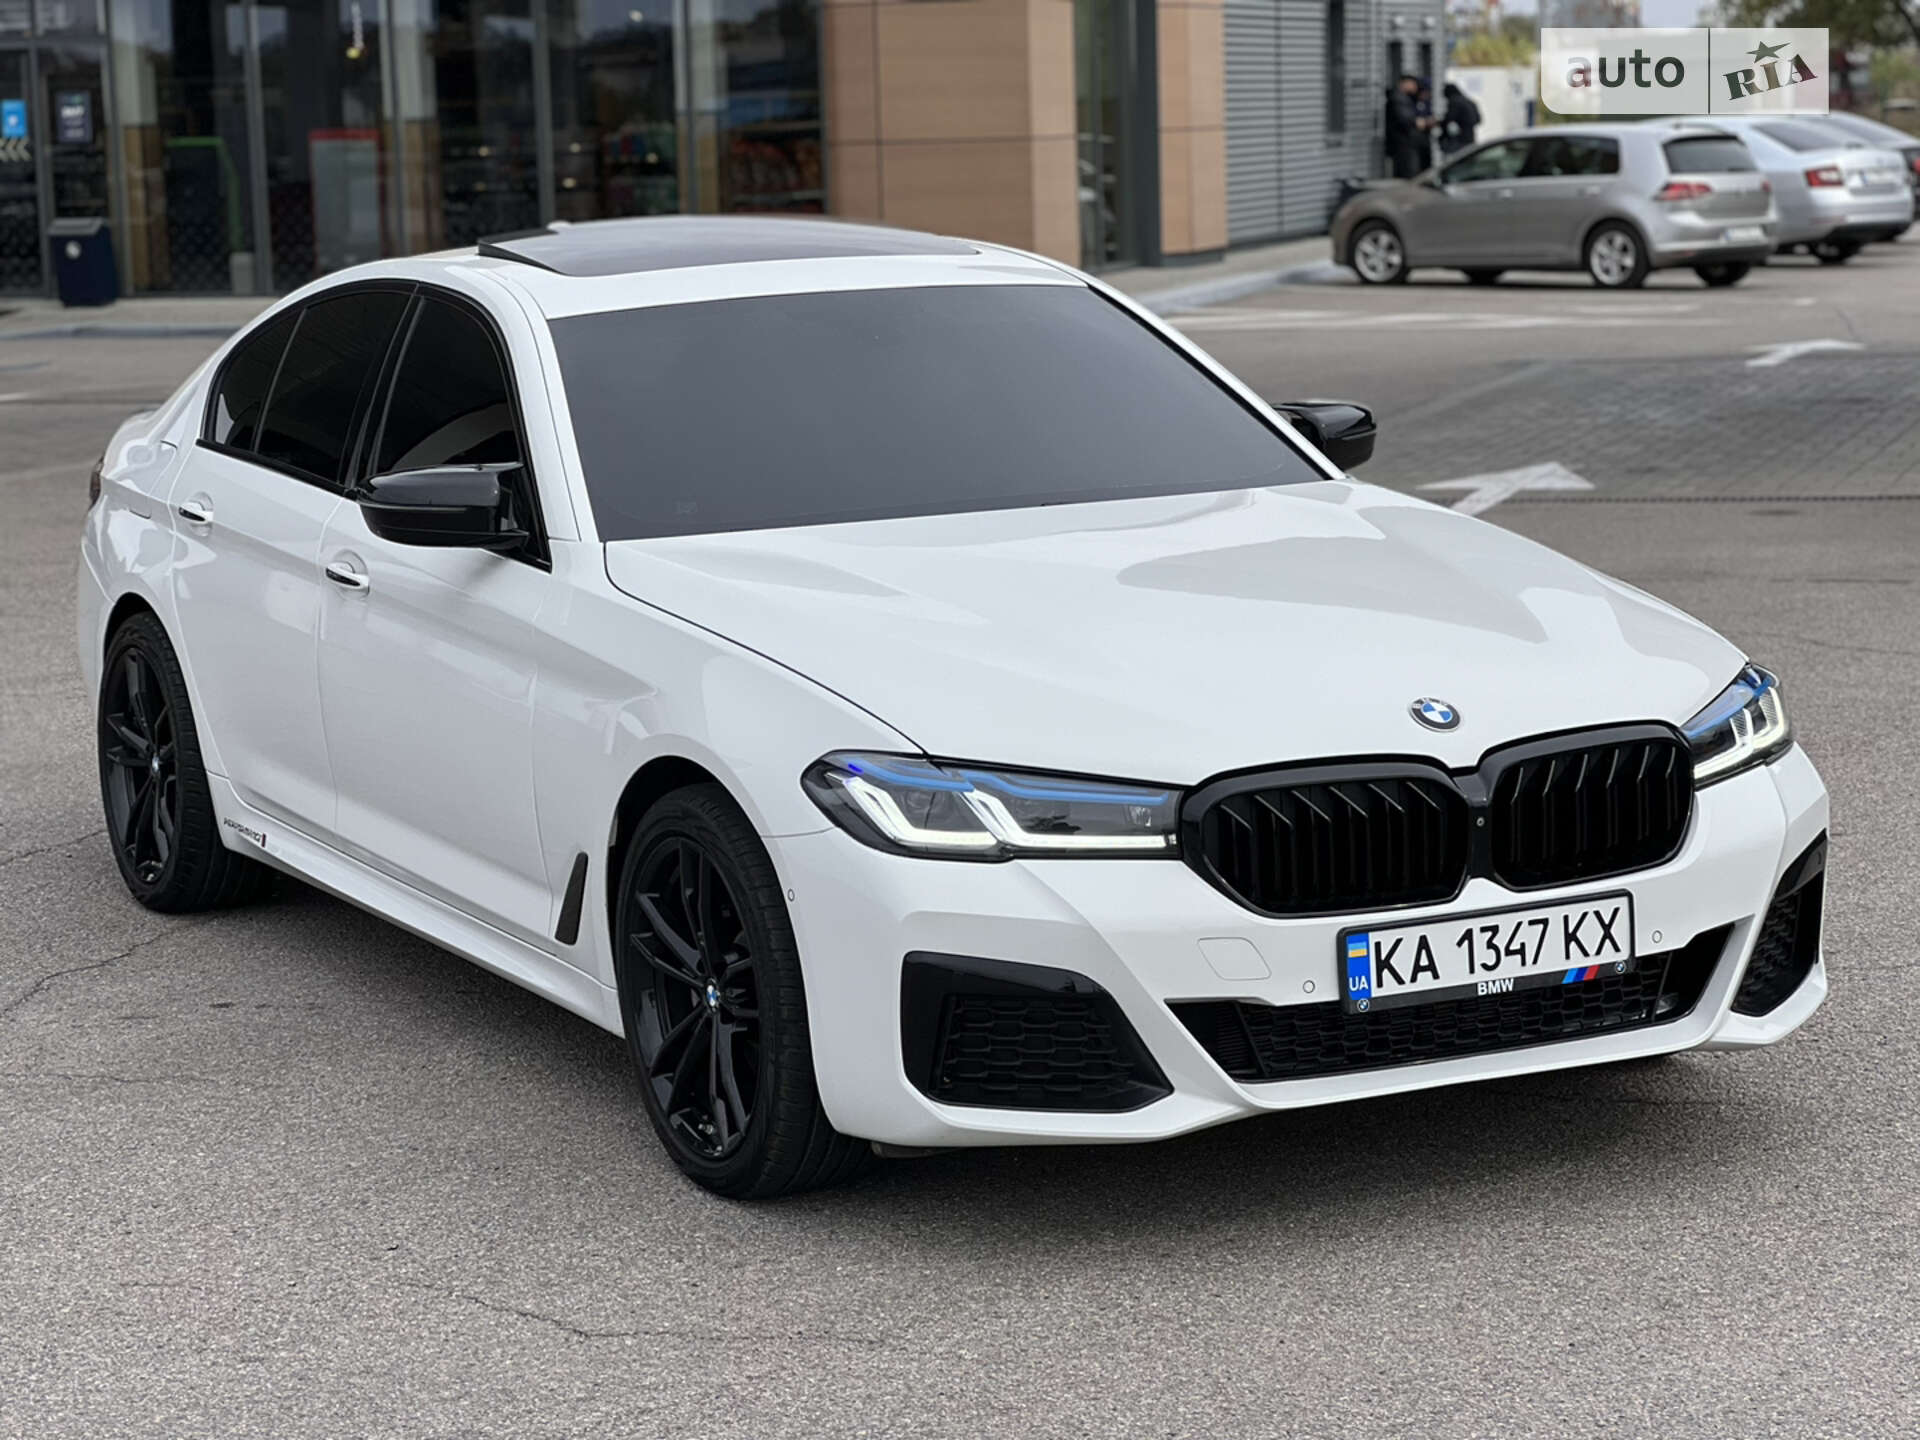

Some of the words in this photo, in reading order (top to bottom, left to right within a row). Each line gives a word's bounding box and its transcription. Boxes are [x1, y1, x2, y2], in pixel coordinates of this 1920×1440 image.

[1374, 934, 1440, 988] KA
[1456, 917, 1550, 974] 1347
[1563, 906, 1621, 960] KX
[1349, 976, 1369, 991] UA
[1477, 978, 1514, 996] BMW
